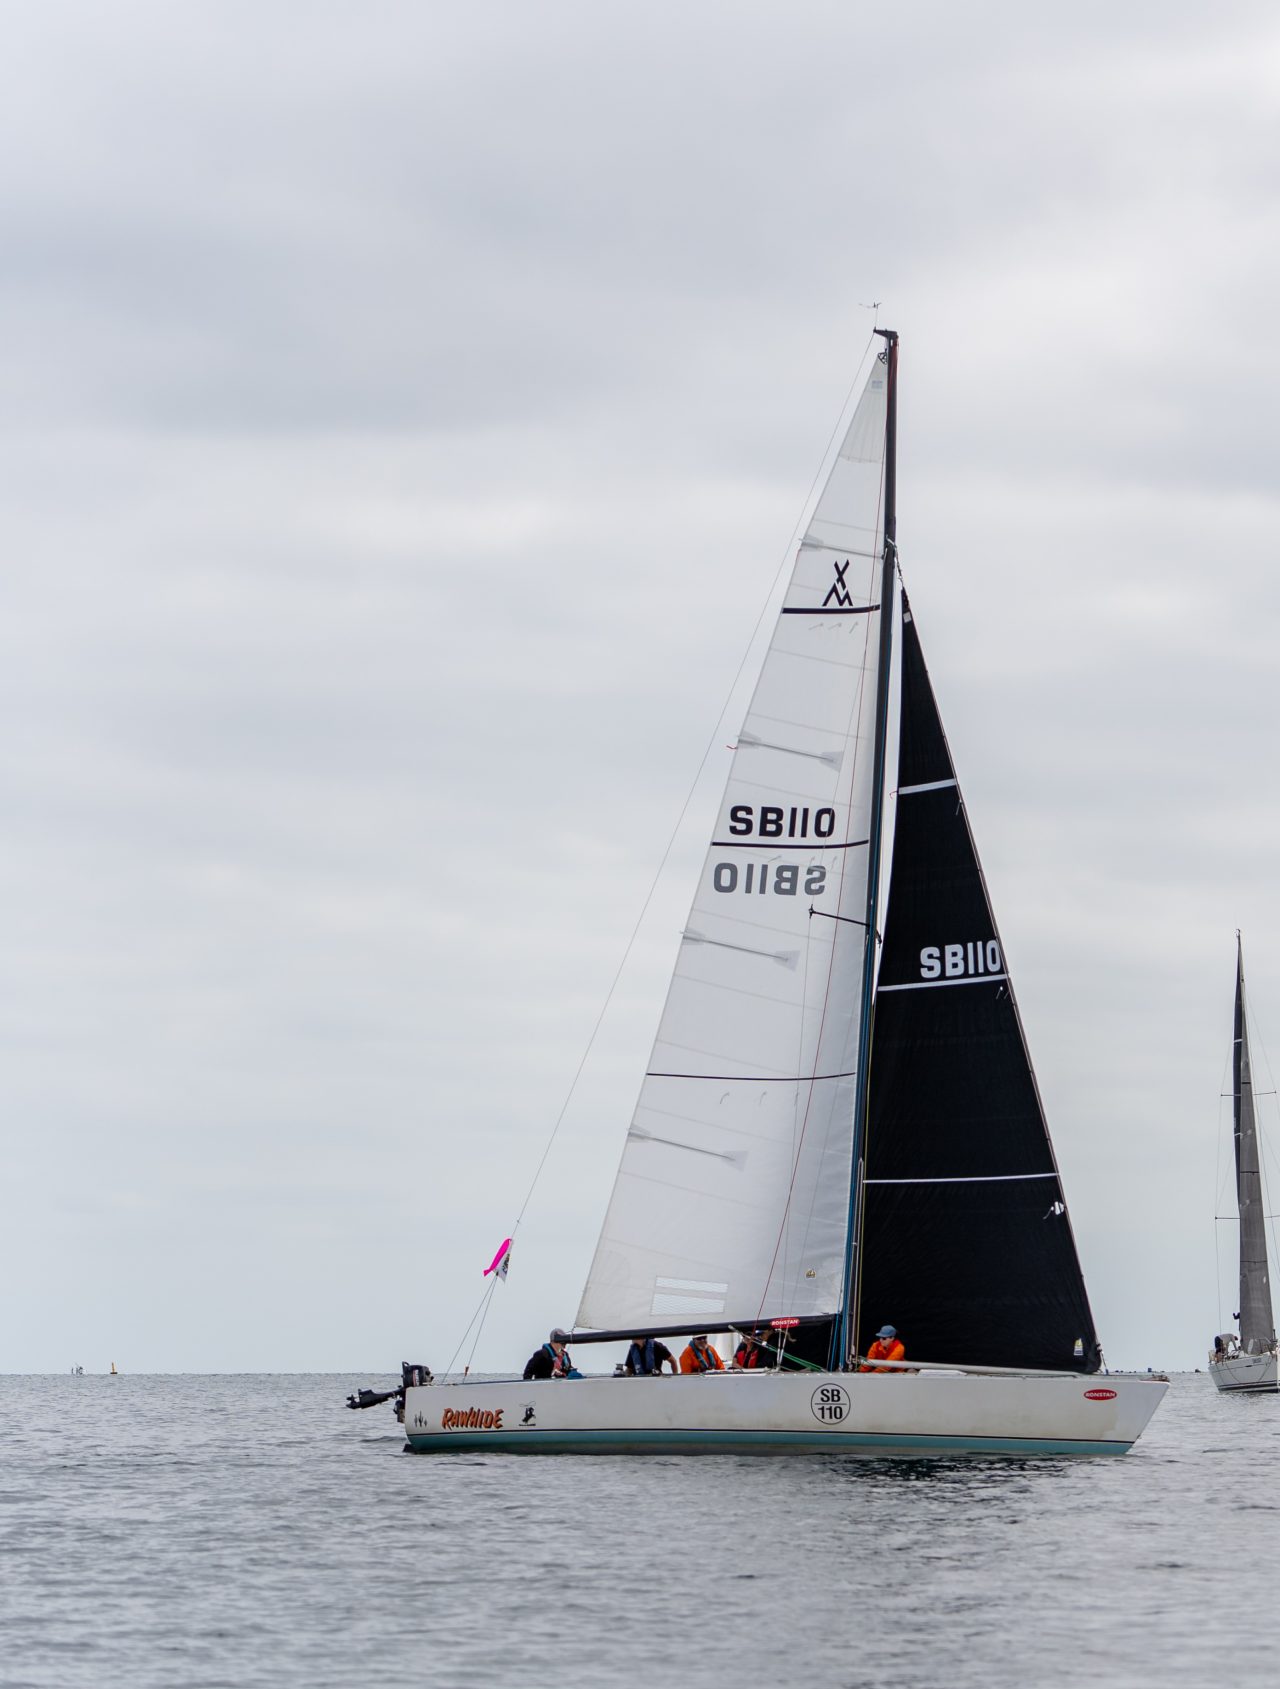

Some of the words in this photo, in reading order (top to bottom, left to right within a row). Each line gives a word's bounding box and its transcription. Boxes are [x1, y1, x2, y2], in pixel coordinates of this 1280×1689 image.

[728, 804, 836, 839] SB110
[920, 939, 1001, 978] SB110
[771, 1318, 799, 1327] RONSTAN
[820, 1388, 841, 1403] SB
[441, 1406, 504, 1431] RAWHIDE
[817, 1405, 843, 1420] 110
